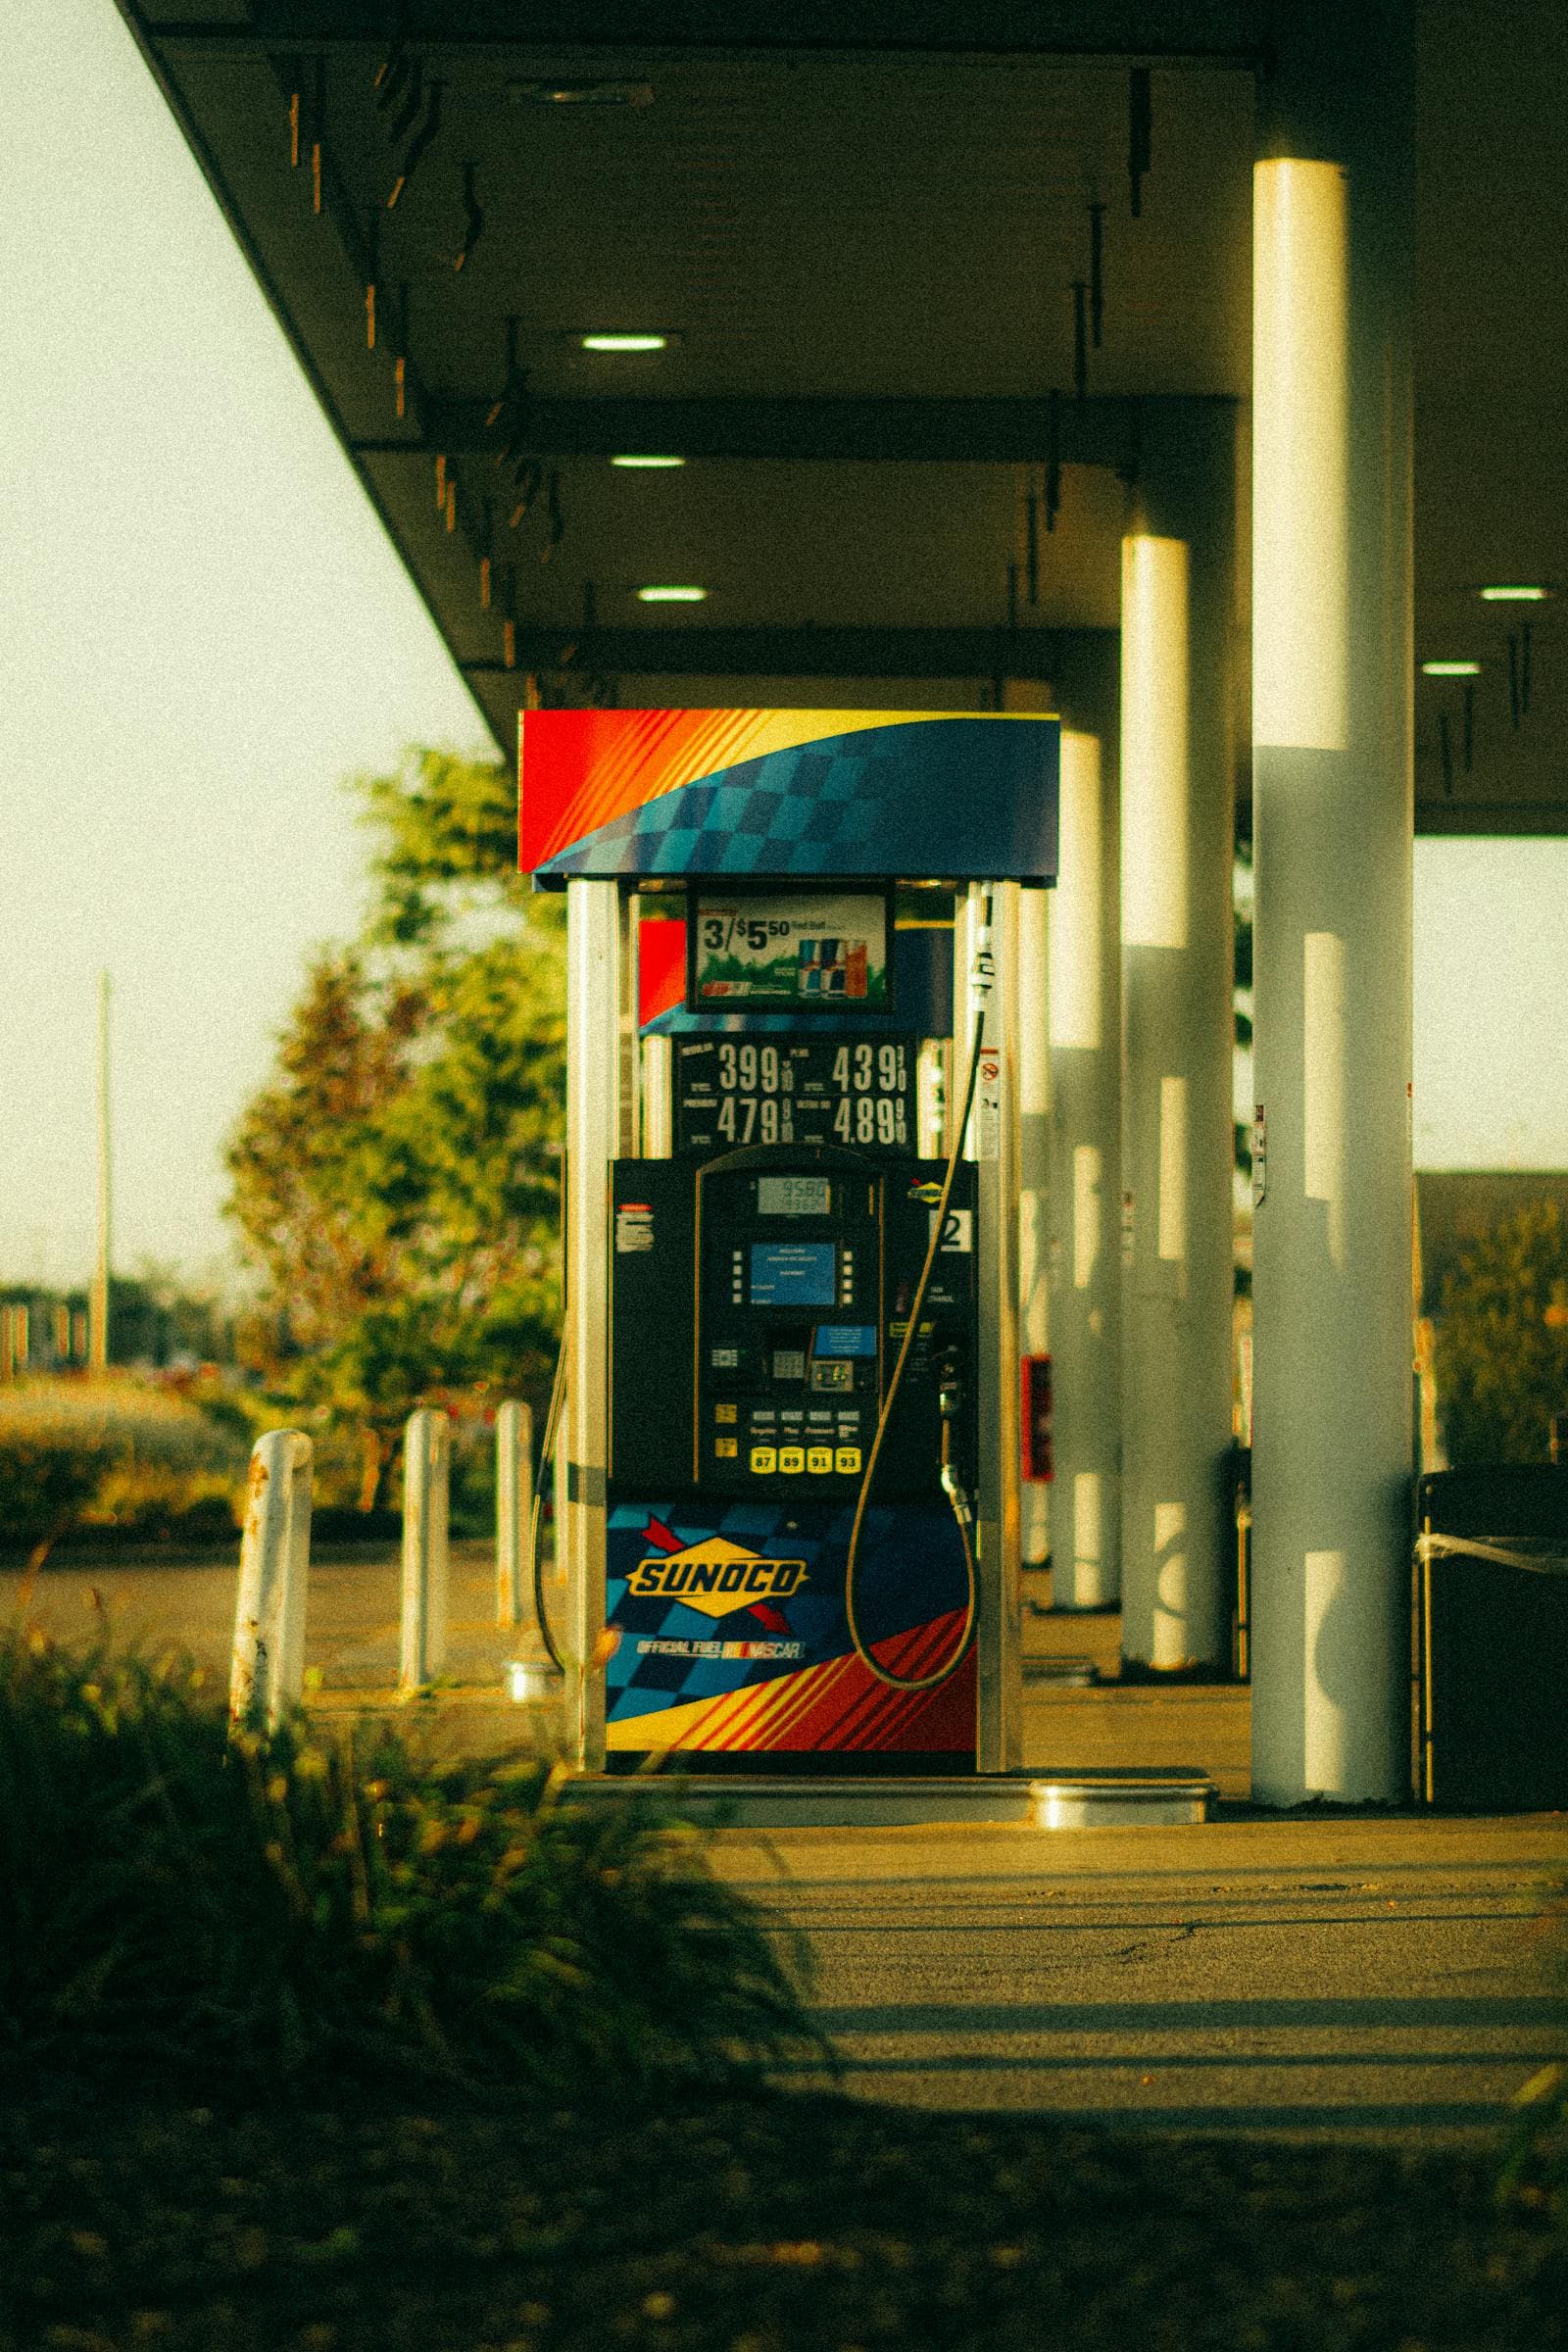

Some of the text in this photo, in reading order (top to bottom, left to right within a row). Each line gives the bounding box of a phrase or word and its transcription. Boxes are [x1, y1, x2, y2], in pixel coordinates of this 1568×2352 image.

[938, 1215, 961, 1246] 2
[756, 1457, 771, 1467] 87
[784, 1457, 800, 1467] 89
[812, 1457, 827, 1467] 91
[840, 1457, 856, 1467] 93
[635, 1564, 801, 1592] SUNOCO
[636, 1640, 806, 1659] OFFICIAL FUEL NASCAR
